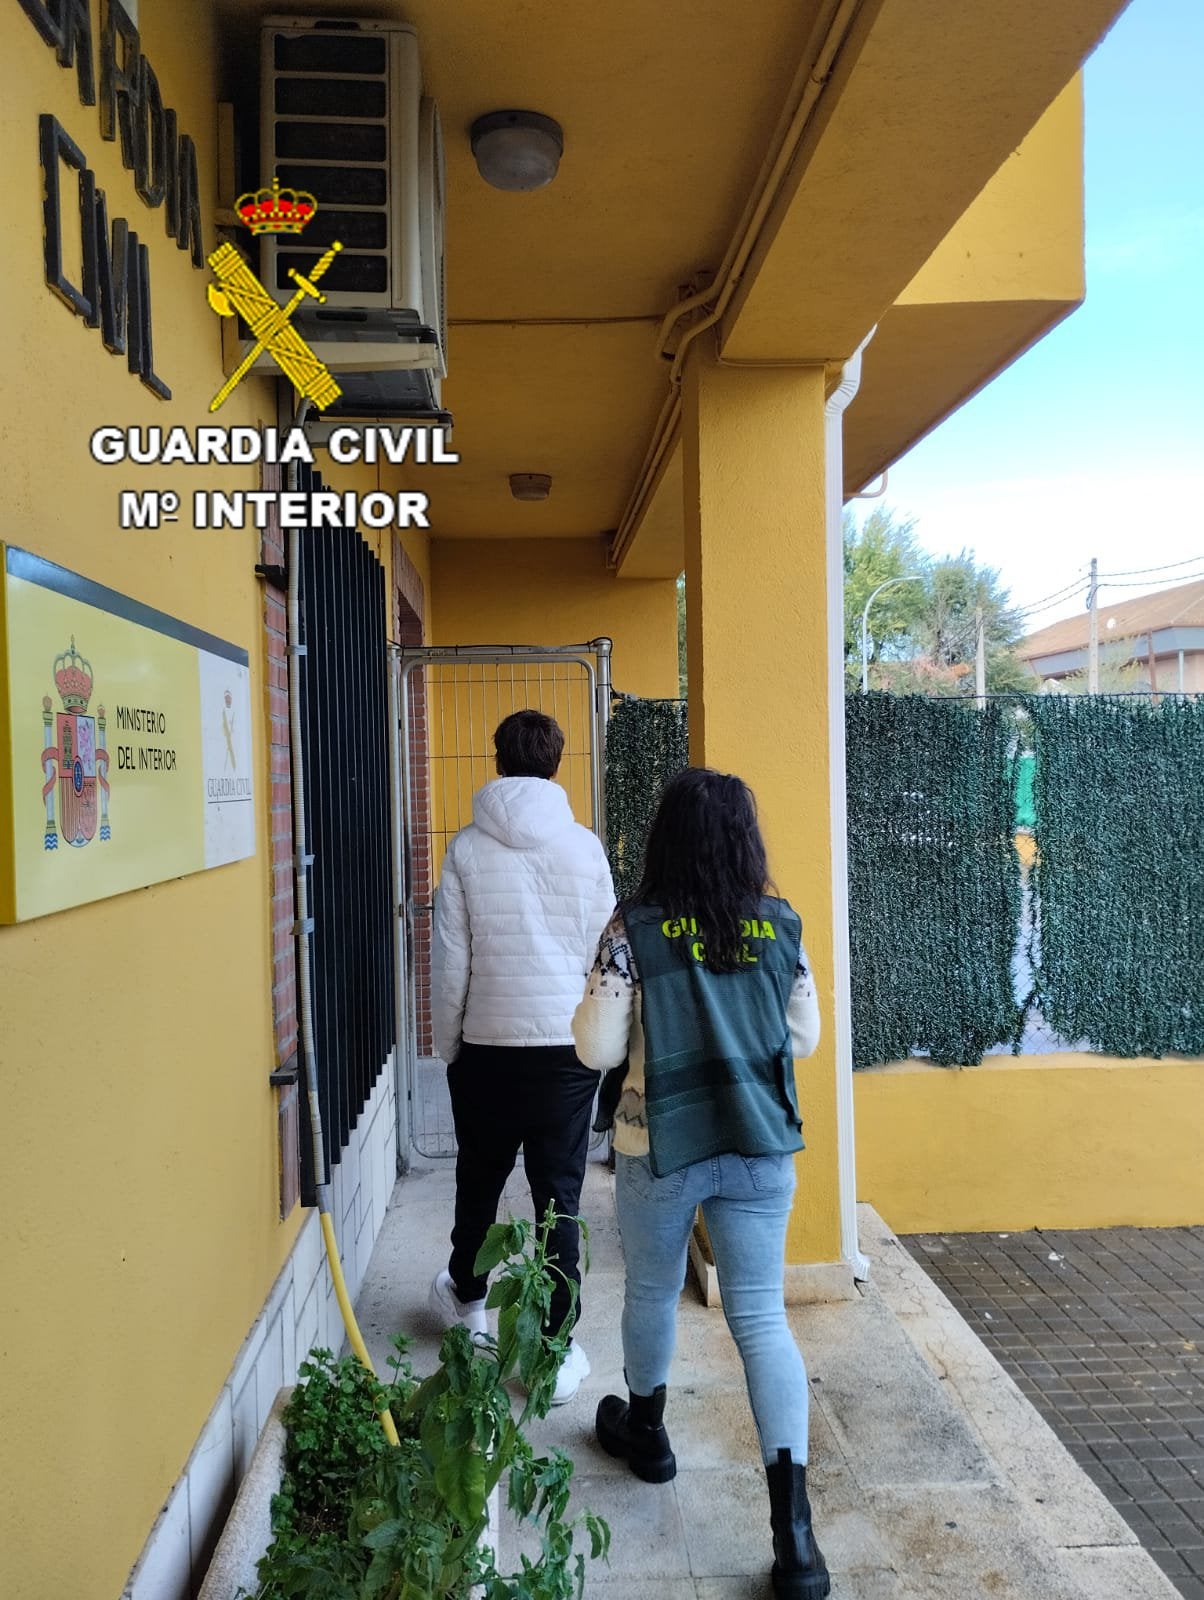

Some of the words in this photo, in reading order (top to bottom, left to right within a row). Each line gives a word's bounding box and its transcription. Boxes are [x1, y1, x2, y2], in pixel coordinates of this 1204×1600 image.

[117, 705, 166, 734] MINISTERIO
[118, 746, 136, 771] DEL
[139, 747, 177, 772] INTERIOR
